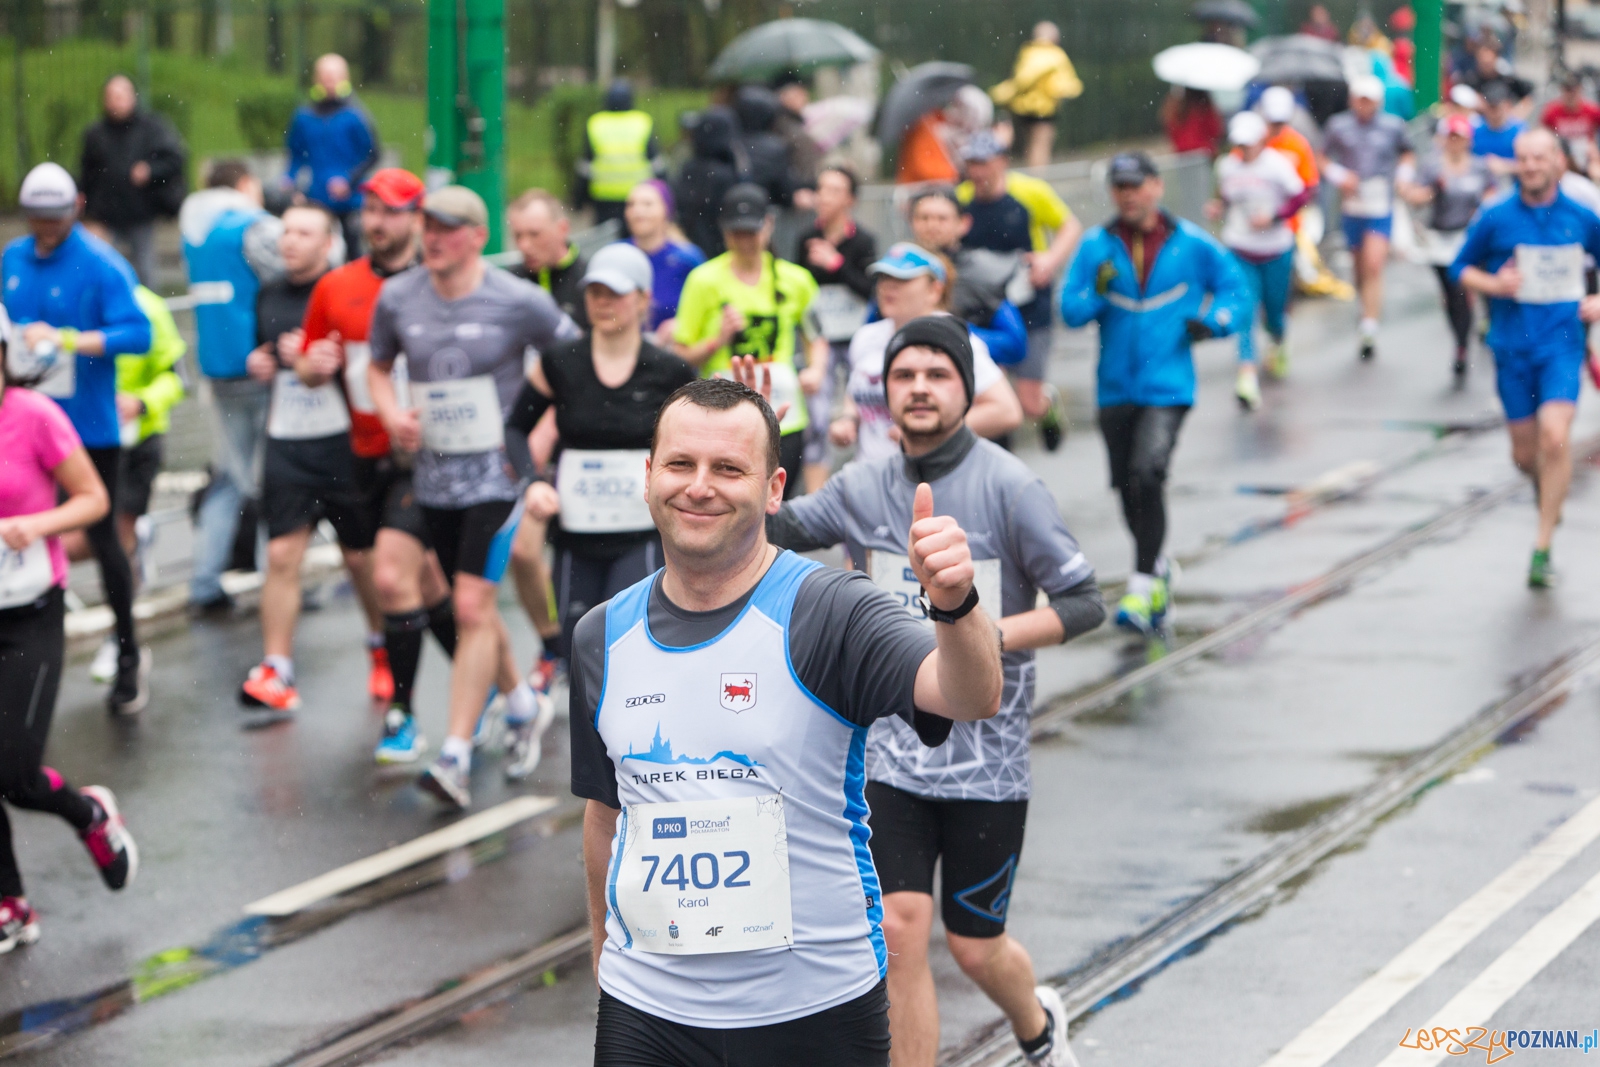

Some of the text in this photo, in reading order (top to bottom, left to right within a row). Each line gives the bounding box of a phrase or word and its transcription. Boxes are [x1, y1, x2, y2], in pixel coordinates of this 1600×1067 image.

[573, 477, 637, 497] 4302
[632, 768, 759, 785] TUREK BIEGA
[641, 850, 751, 892] 7402
[678, 897, 709, 908] Karol
[705, 926, 724, 937] 4F
